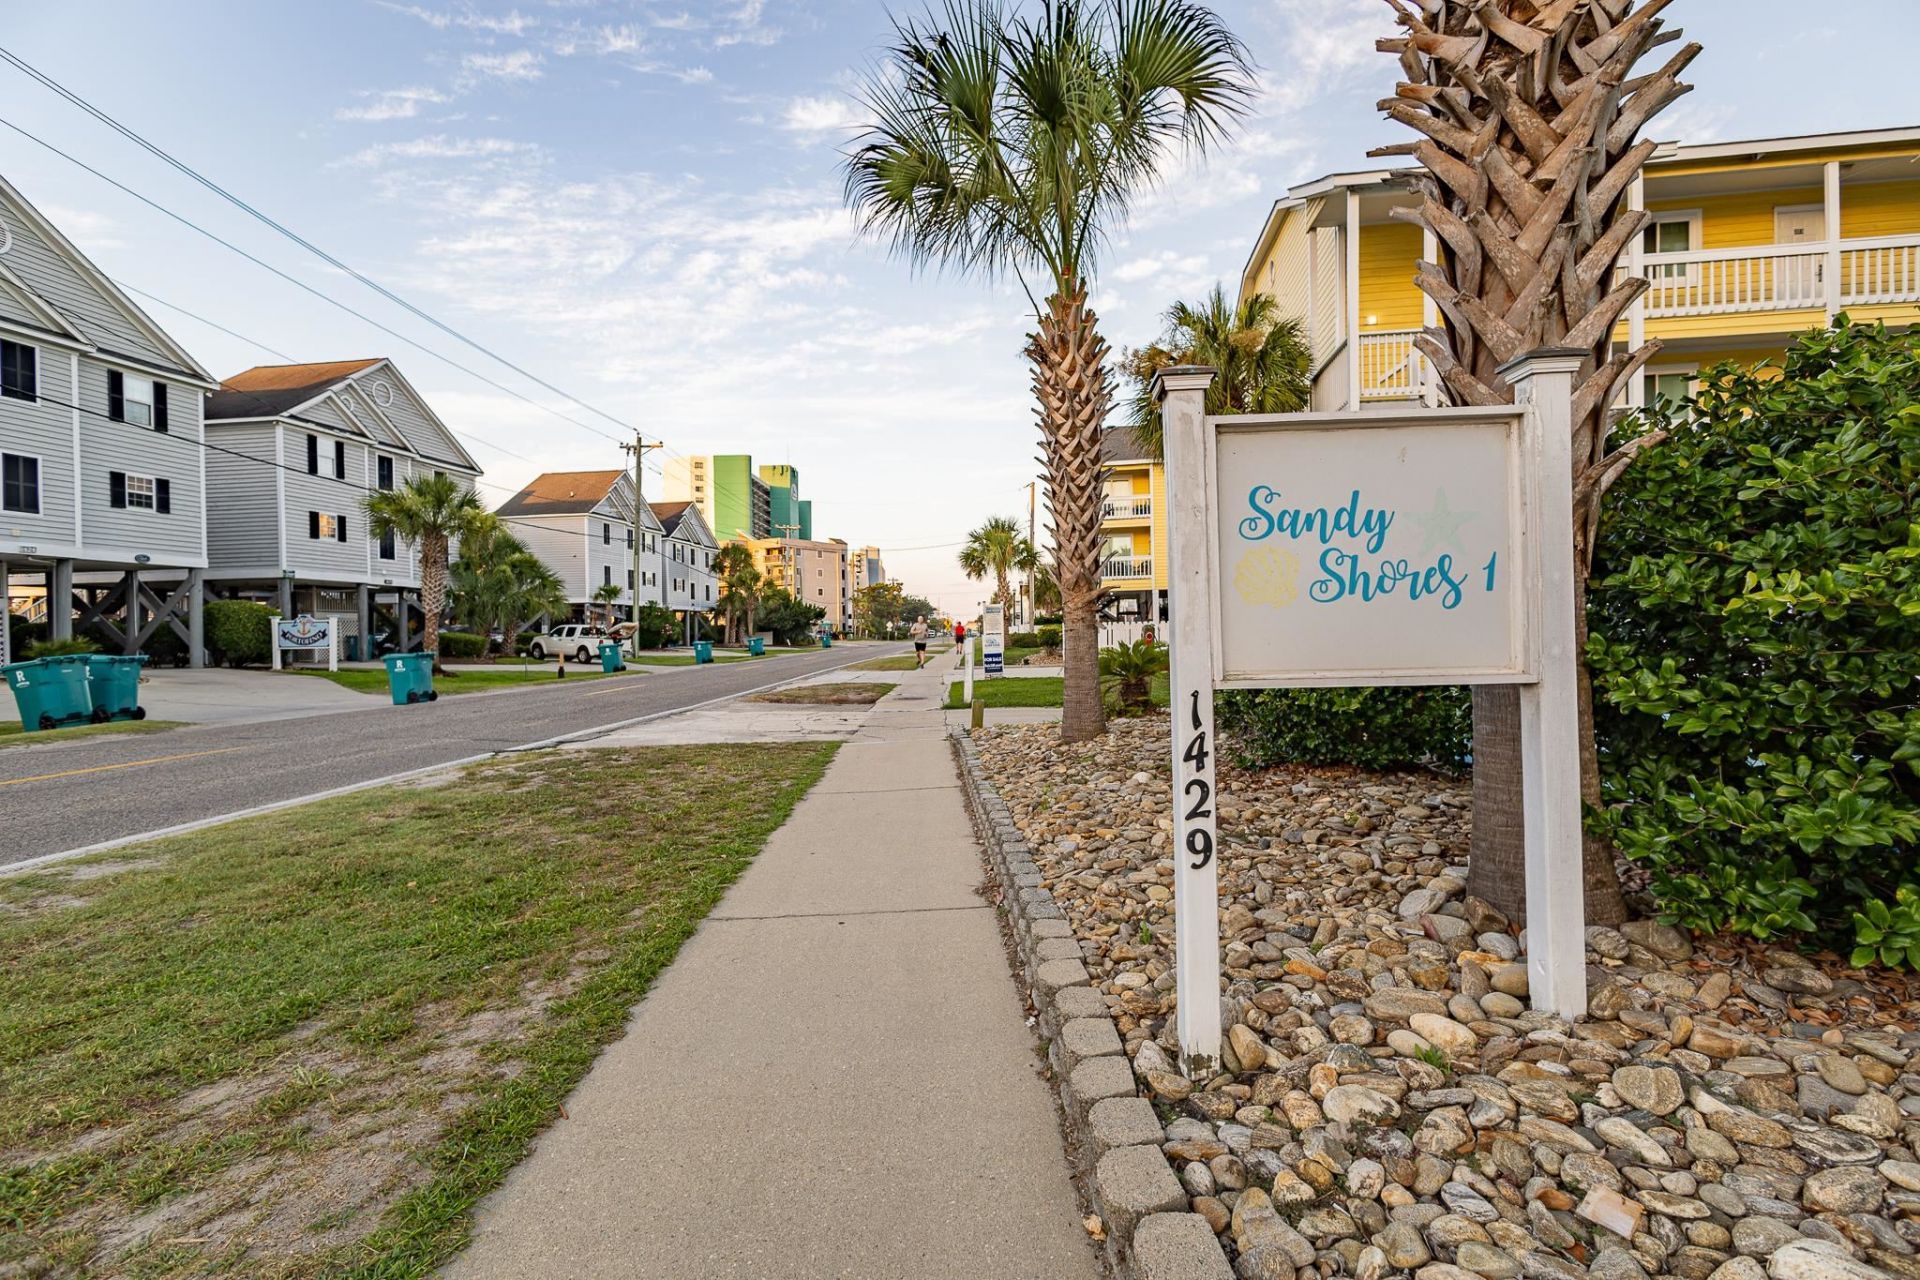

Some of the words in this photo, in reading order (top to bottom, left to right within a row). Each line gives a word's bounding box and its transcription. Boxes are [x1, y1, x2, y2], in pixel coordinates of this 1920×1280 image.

[1238, 485, 1395, 554] Sandy
[1309, 547, 1468, 609] Shores
[1482, 551, 1497, 592] 1
[15, 670, 26, 682] R
[1183, 690, 1213, 870] 1429
